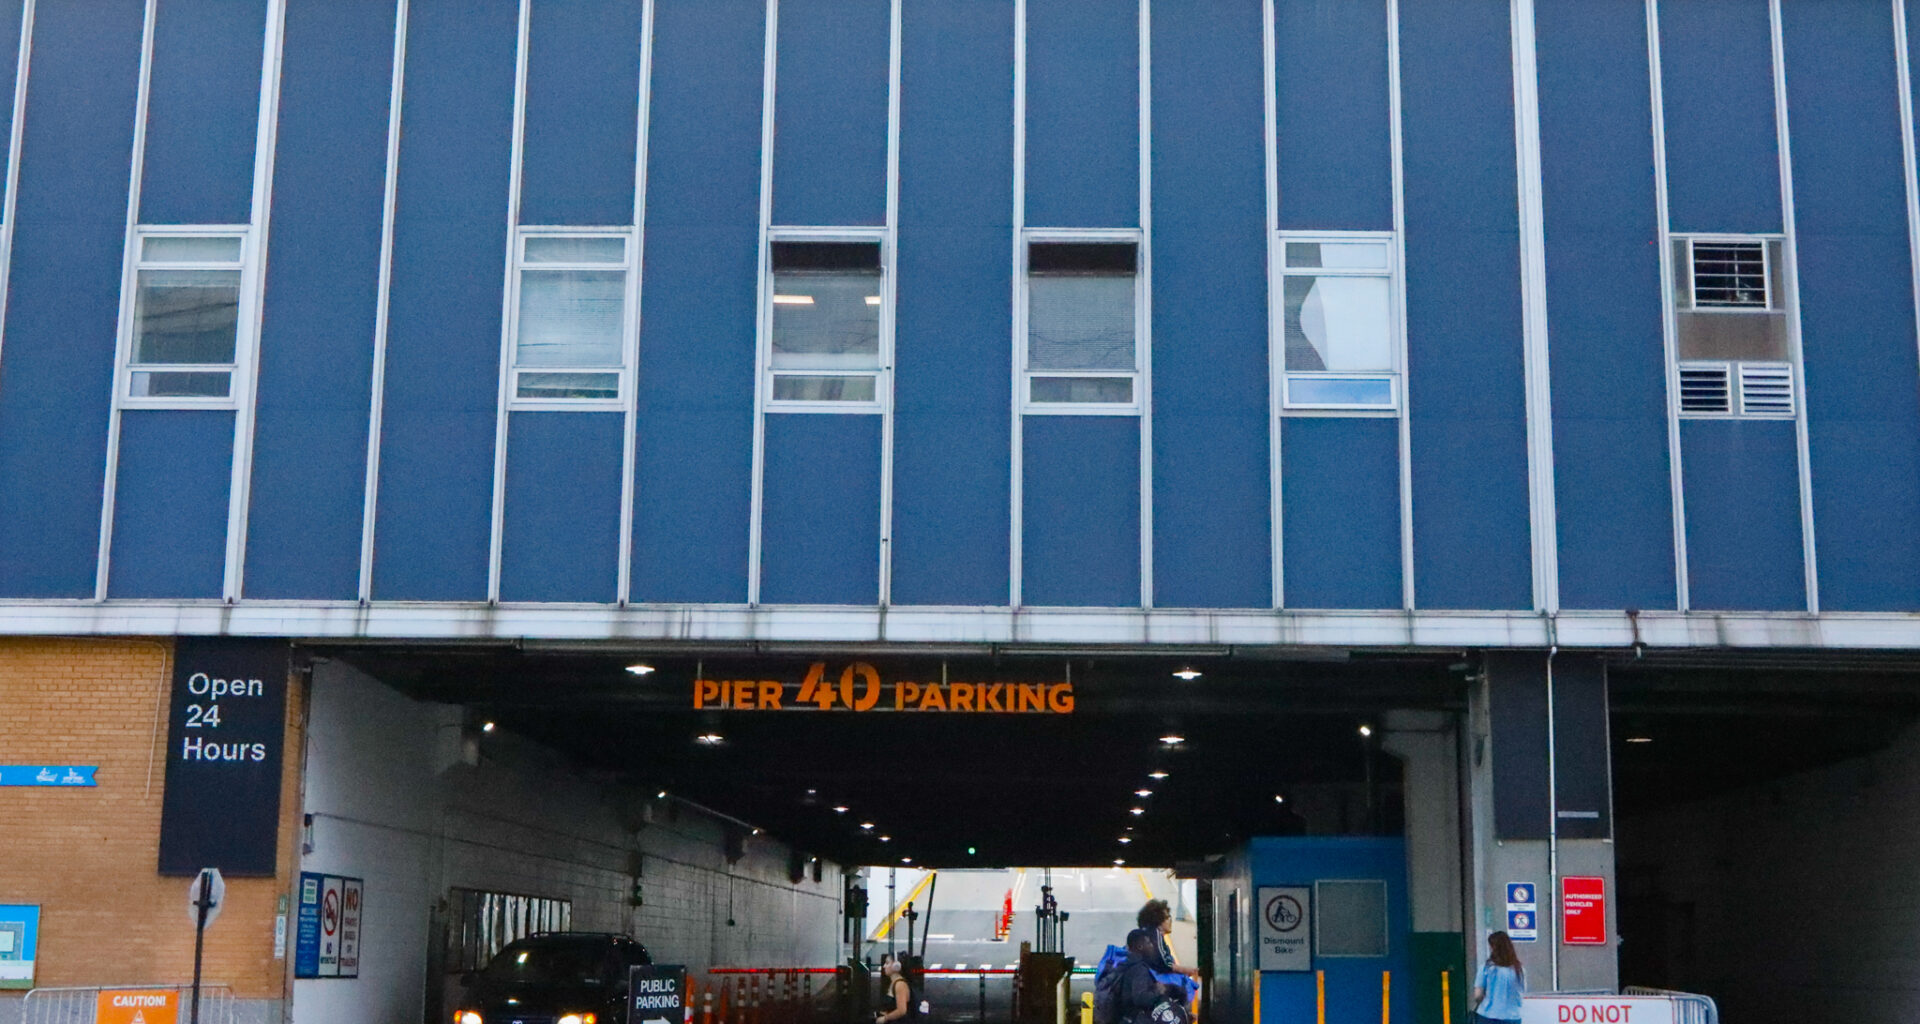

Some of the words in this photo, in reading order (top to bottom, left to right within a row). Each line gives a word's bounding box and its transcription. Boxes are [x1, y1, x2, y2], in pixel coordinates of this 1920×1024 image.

[188, 672, 264, 700] Open
[694, 680, 784, 710] PIER
[795, 661, 881, 711] 40
[895, 682, 1074, 714] PARKING
[185, 704, 221, 728] 24
[183, 736, 266, 761] Hours
[345, 887, 359, 912] NO
[1264, 937, 1304, 945] Dismount
[1274, 946, 1294, 954] Bike
[640, 979, 676, 992] PUBLIC
[113, 995, 167, 1007] CAUTION!
[636, 995, 680, 1009] PARKING
[1558, 1004, 1587, 1023] DO
[1591, 1004, 1632, 1023] NOT
